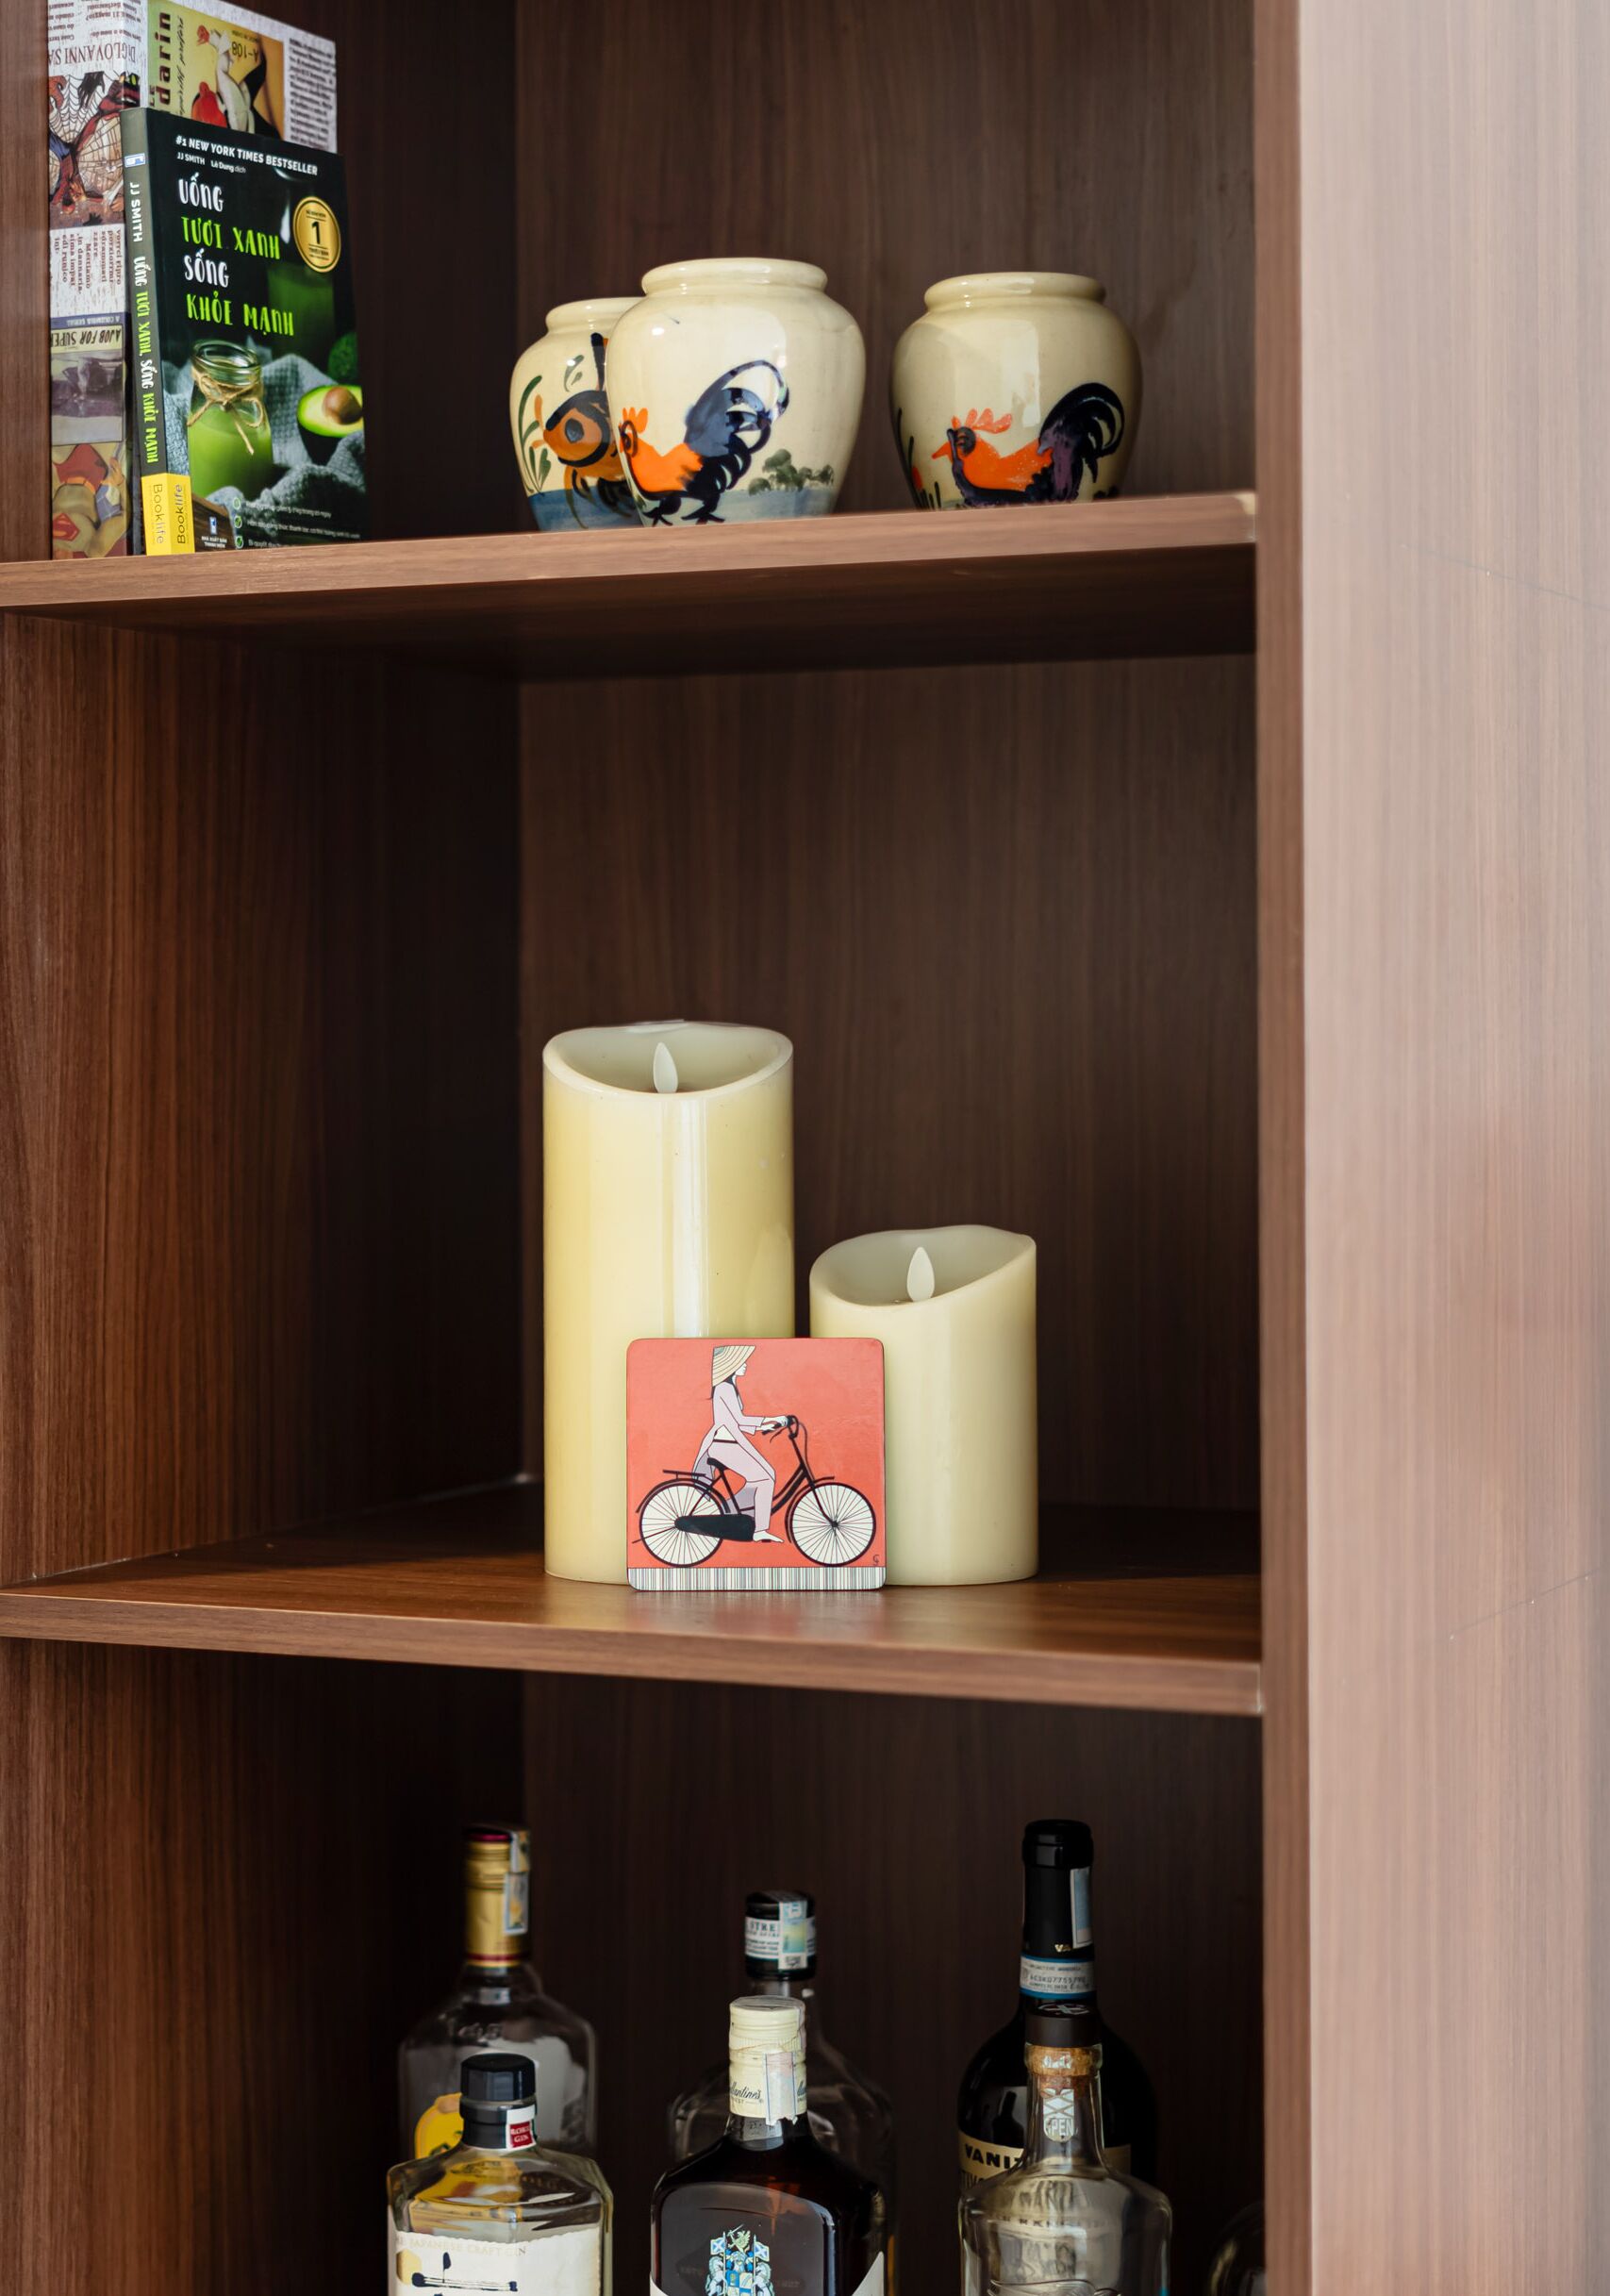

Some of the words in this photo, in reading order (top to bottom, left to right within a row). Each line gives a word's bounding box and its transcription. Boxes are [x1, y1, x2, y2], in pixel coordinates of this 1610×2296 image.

[155, 12, 171, 112] darin
[175, 135, 188, 147] #1
[189, 138, 210, 153] NEW
[211, 142, 236, 158] YORK
[237, 148, 264, 164] TIMES
[265, 155, 319, 176] BESTSELLER
[176, 152, 185, 160] JJ
[185, 154, 206, 165] SMITH
[130, 182, 141, 195] JJ
[178, 172, 224, 212] UỐNG
[131, 199, 143, 242] SMITH
[311, 220, 321, 244] 1
[181, 216, 223, 249] TƯƠI
[232, 226, 280, 260] XANH
[133, 256, 151, 287] UỐNG
[184, 248, 229, 288] SỐNG
[136, 291, 151, 318] TƯƠI
[187, 291, 233, 325] KHỎE
[243, 303, 294, 336] MẠNH
[79, 329, 98, 345] FOR
[99, 329, 114, 344] JOB
[115, 329, 122, 342] A
[141, 359, 158, 389] SỐNG
[153, 484, 166, 544] Booklife
[174, 484, 186, 544] Booklife
[731, 2080, 762, 2100] llantine's
[514, 2135, 529, 2143] GIN
[409, 2238, 462, 2252] JAPANESE
[468, 2244, 500, 2254] CRAFT
